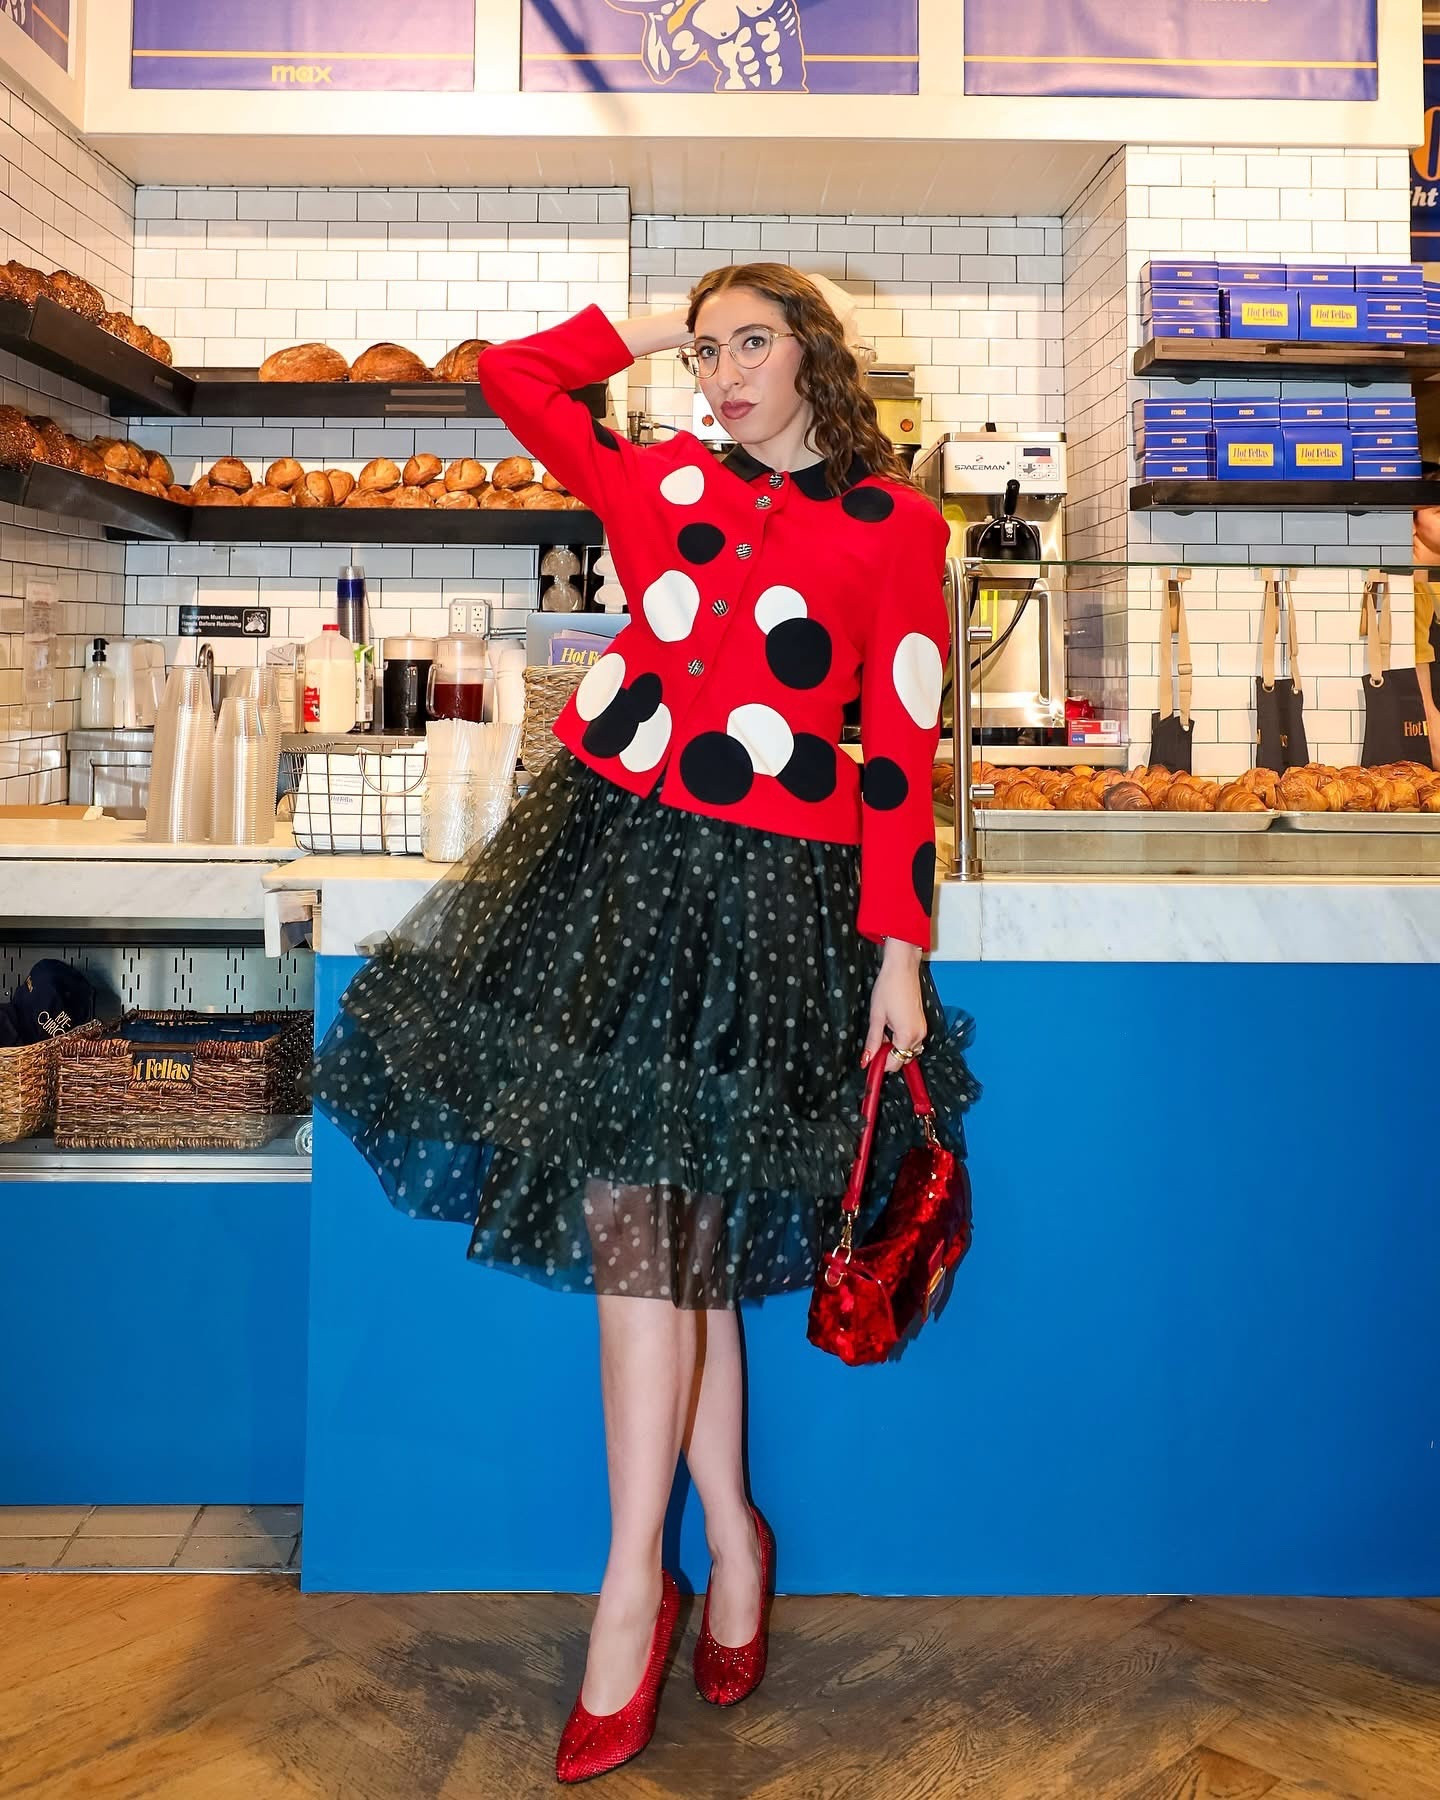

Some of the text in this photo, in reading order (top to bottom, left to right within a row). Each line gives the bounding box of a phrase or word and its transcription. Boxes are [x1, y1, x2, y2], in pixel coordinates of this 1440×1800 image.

[271, 65, 333, 83] max
[1410, 186, 1439, 207] ht
[560, 648, 587, 665] Hot
[1403, 720, 1424, 737] Hot
[146, 1059, 190, 1080] Fellas
